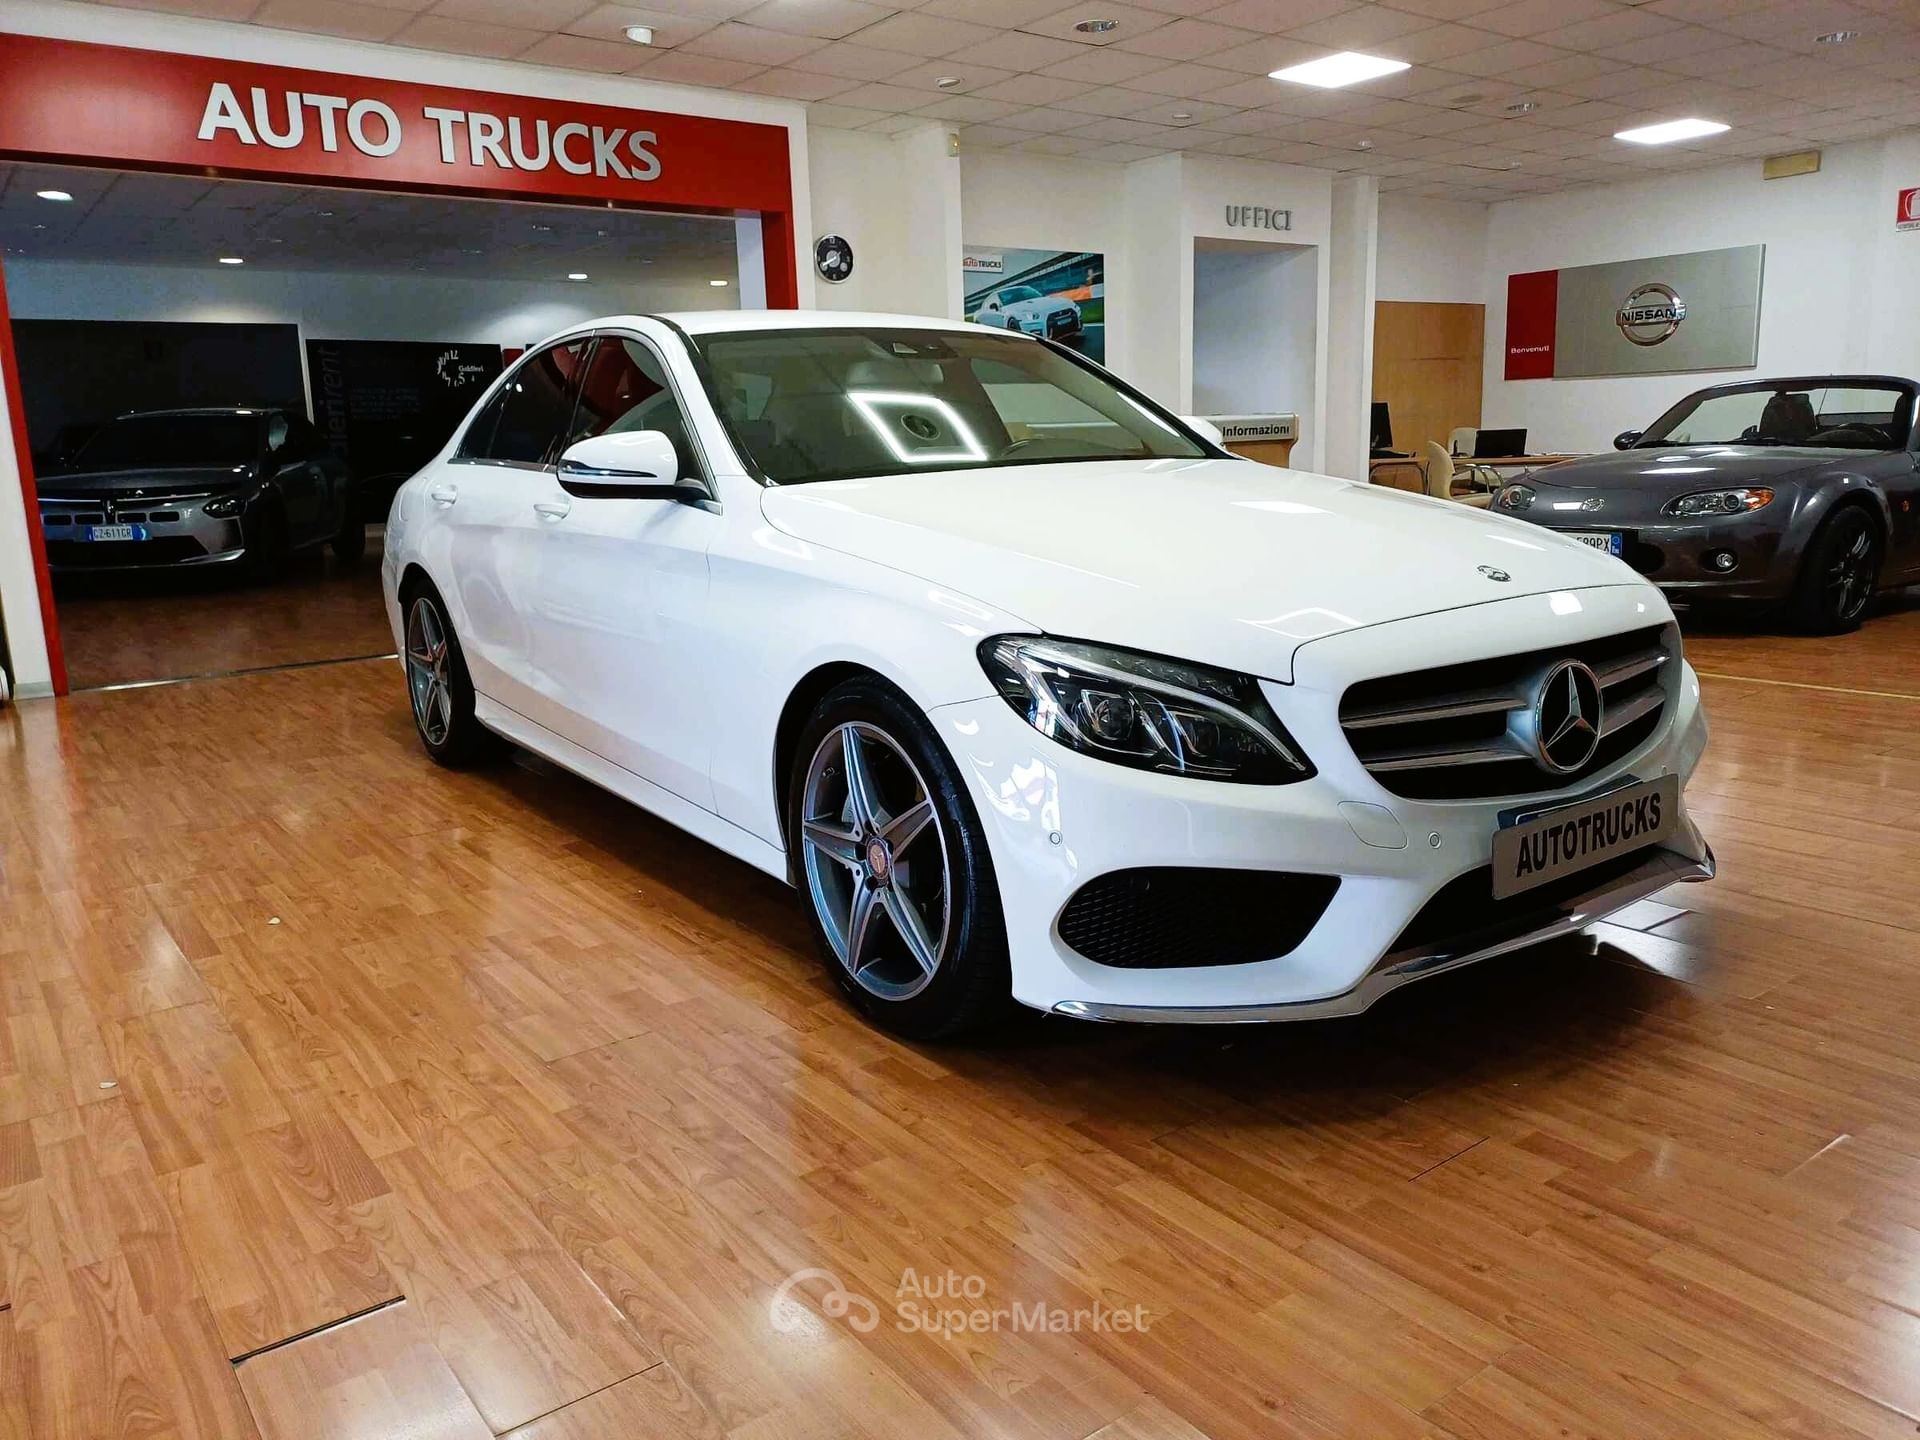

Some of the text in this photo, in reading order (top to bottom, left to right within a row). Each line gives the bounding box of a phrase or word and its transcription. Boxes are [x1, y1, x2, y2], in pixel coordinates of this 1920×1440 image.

[197, 82, 662, 182] AUTO TRUCKS
[1225, 205, 1293, 231] UFFICI
[978, 260, 1002, 269] TRUCKS
[1621, 308, 1677, 322] NISSAN
[1510, 345, 1550, 354] Benvenuti
[1222, 424, 1290, 437] Informazioni
[1516, 792, 1661, 878] AUTOTRUCKS
